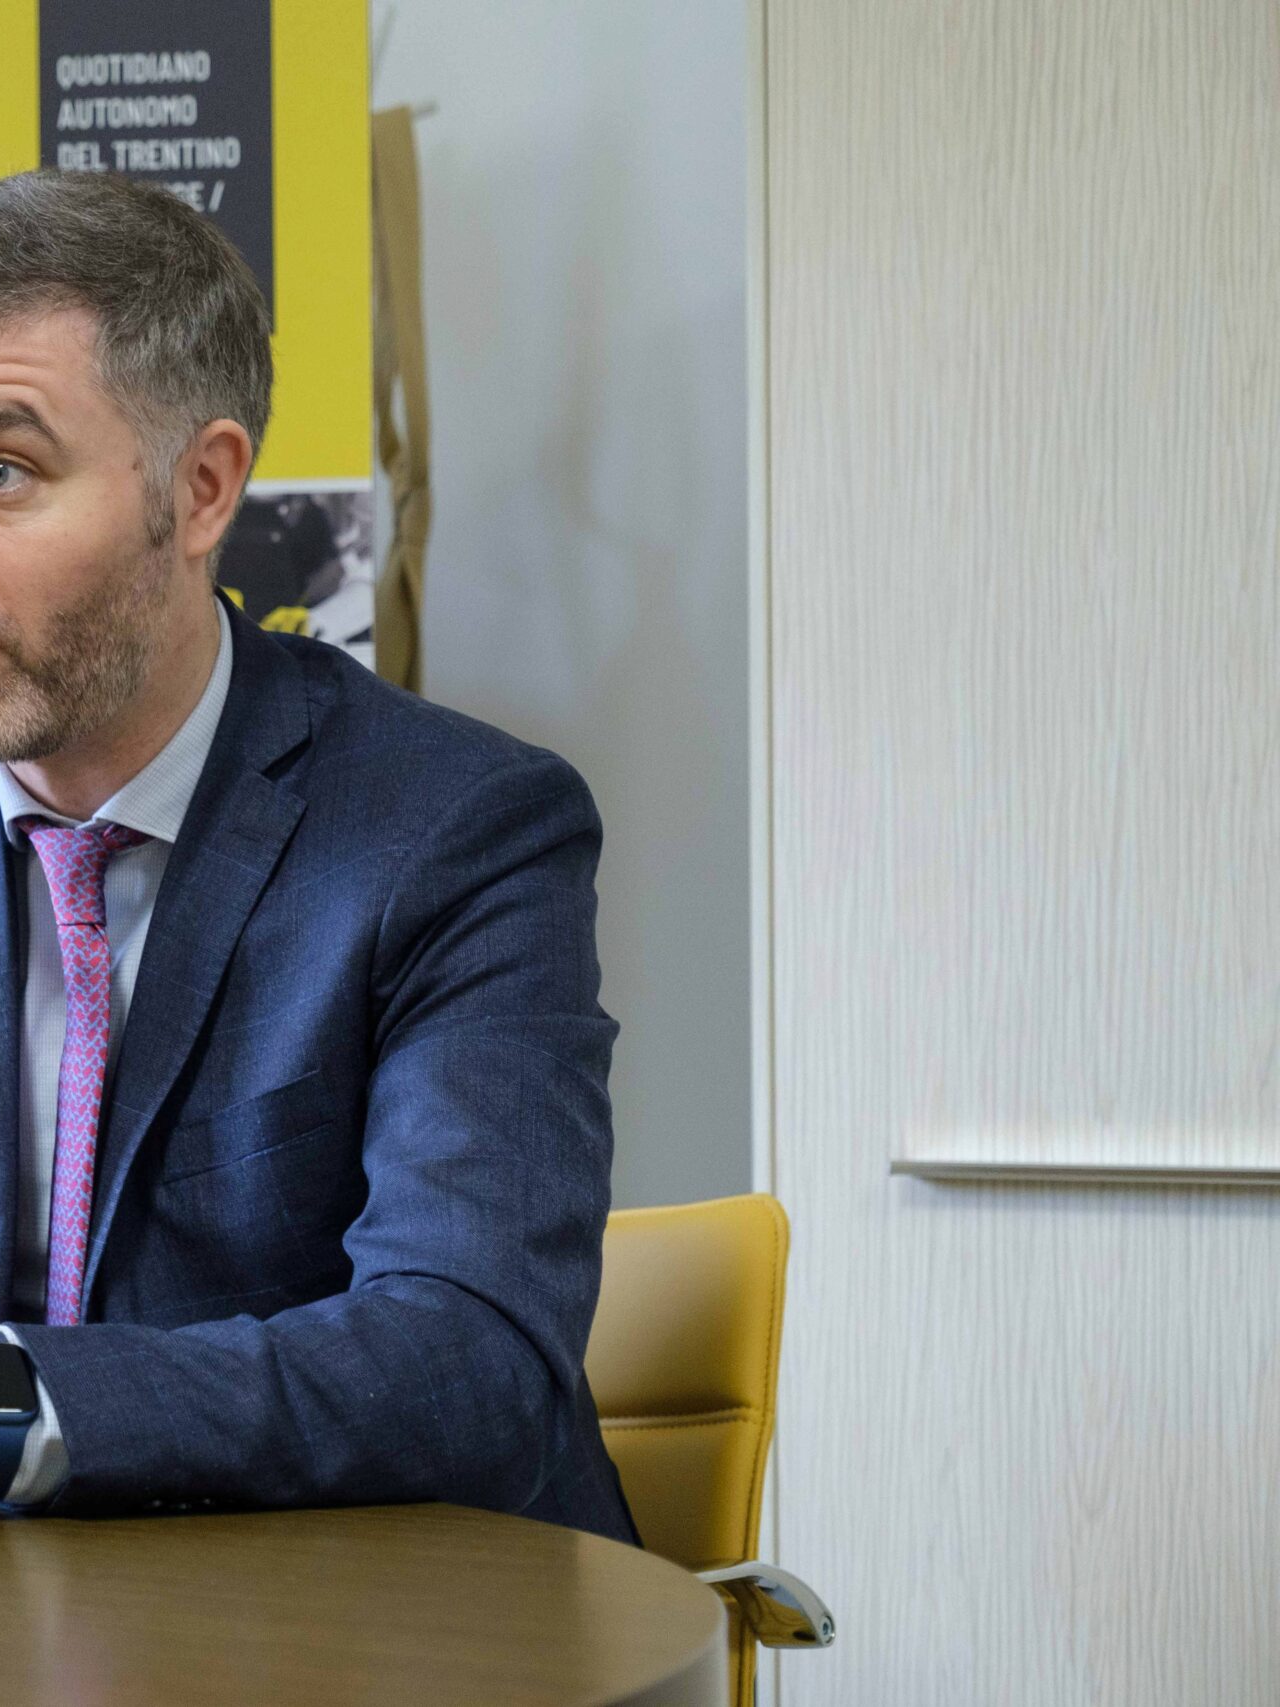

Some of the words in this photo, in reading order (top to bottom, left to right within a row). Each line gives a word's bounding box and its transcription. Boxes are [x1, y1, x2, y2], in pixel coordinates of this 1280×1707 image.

[56, 50, 211, 91] QUOTIDIANO
[56, 95, 198, 131] AUTONOMO
[57, 141, 108, 171] DEL
[111, 136, 242, 171] TRENTINO
